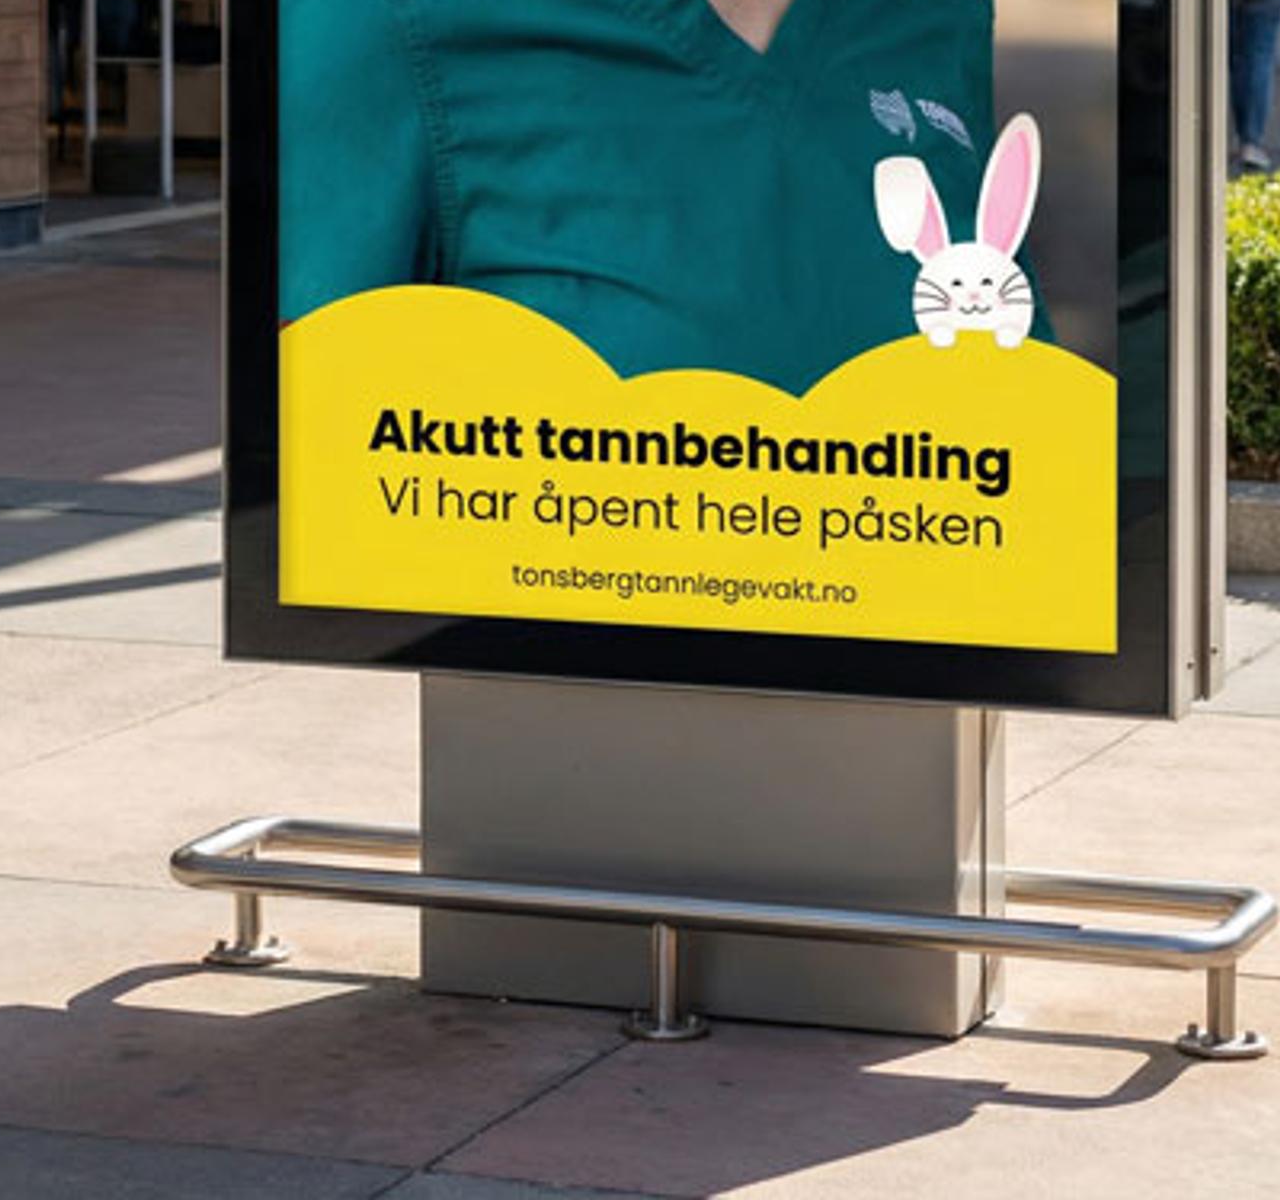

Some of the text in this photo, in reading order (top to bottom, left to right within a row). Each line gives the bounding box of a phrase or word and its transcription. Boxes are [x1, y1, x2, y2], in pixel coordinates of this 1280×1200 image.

[368, 409, 1012, 495] Akutt tannbehandling
[379, 476, 1004, 550] Vi har åpent hele påsken
[512, 565, 858, 605] tonsbergtannlegevakt.no
